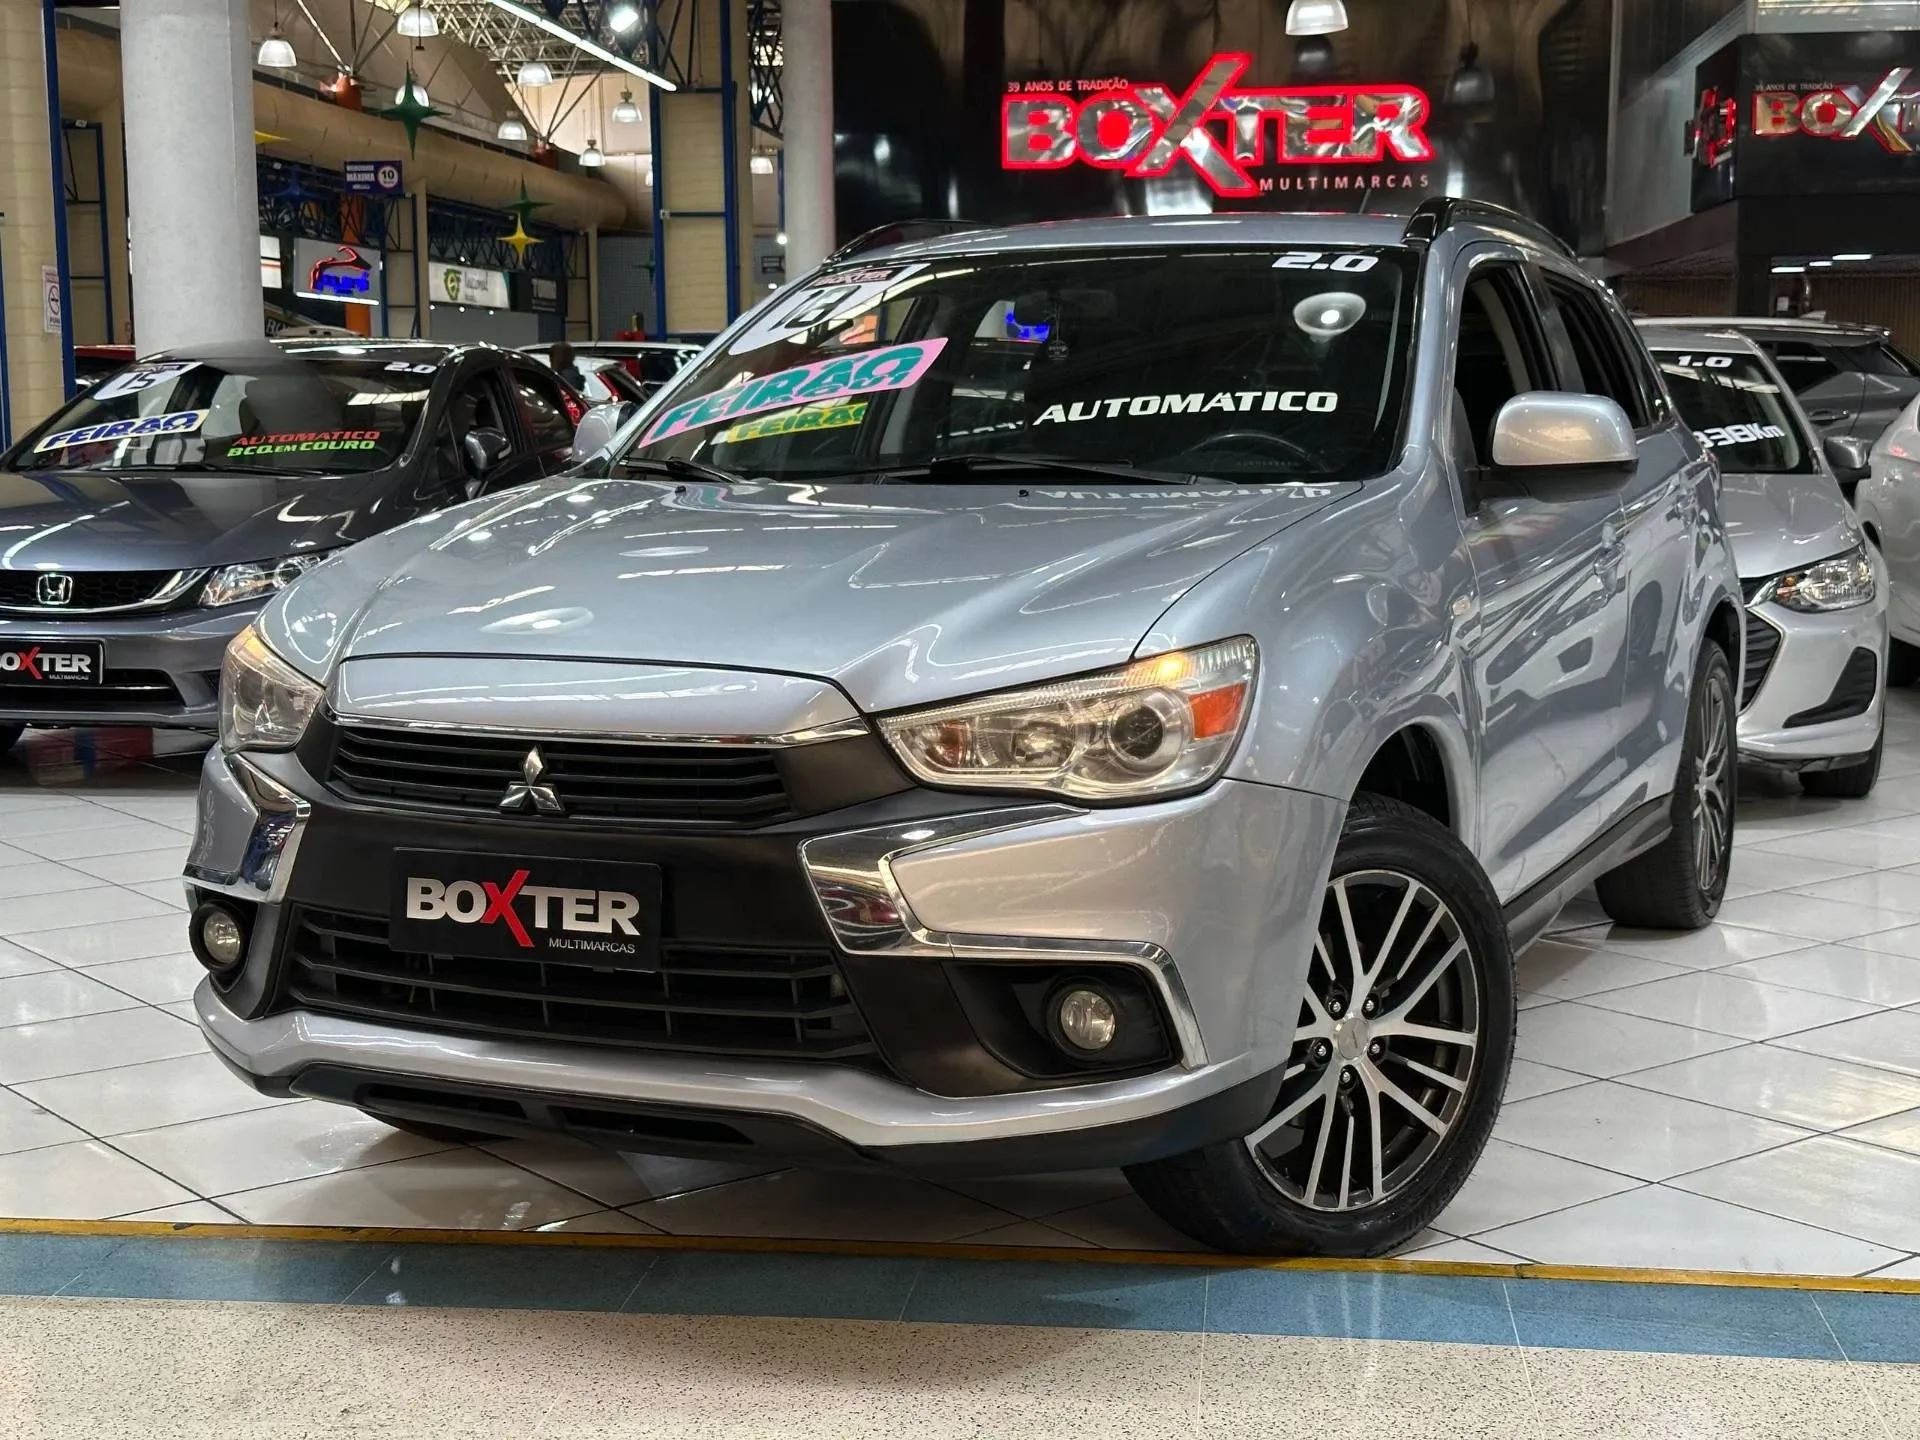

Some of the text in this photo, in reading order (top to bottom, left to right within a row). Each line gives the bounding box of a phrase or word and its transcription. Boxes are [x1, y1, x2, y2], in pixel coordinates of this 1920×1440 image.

[1007, 77, 1129, 93] 39 ANOS DE TRADIÇÃO
[1002, 52, 1437, 197] BOXTER
[381, 169, 395, 181] 10
[1258, 174, 1430, 192] MULTIMARCAS
[1271, 251, 1379, 272] 2.0
[384, 361, 437, 374] 2.0
[1678, 355, 1733, 368] 1.0
[1032, 390, 1339, 426] AUTOMATICO
[232, 430, 382, 446] AUTOMATICO
[299, 440, 376, 451] COURO
[406, 869, 641, 948] BOXTER
[548, 936, 636, 955] MULTIMARCAS
